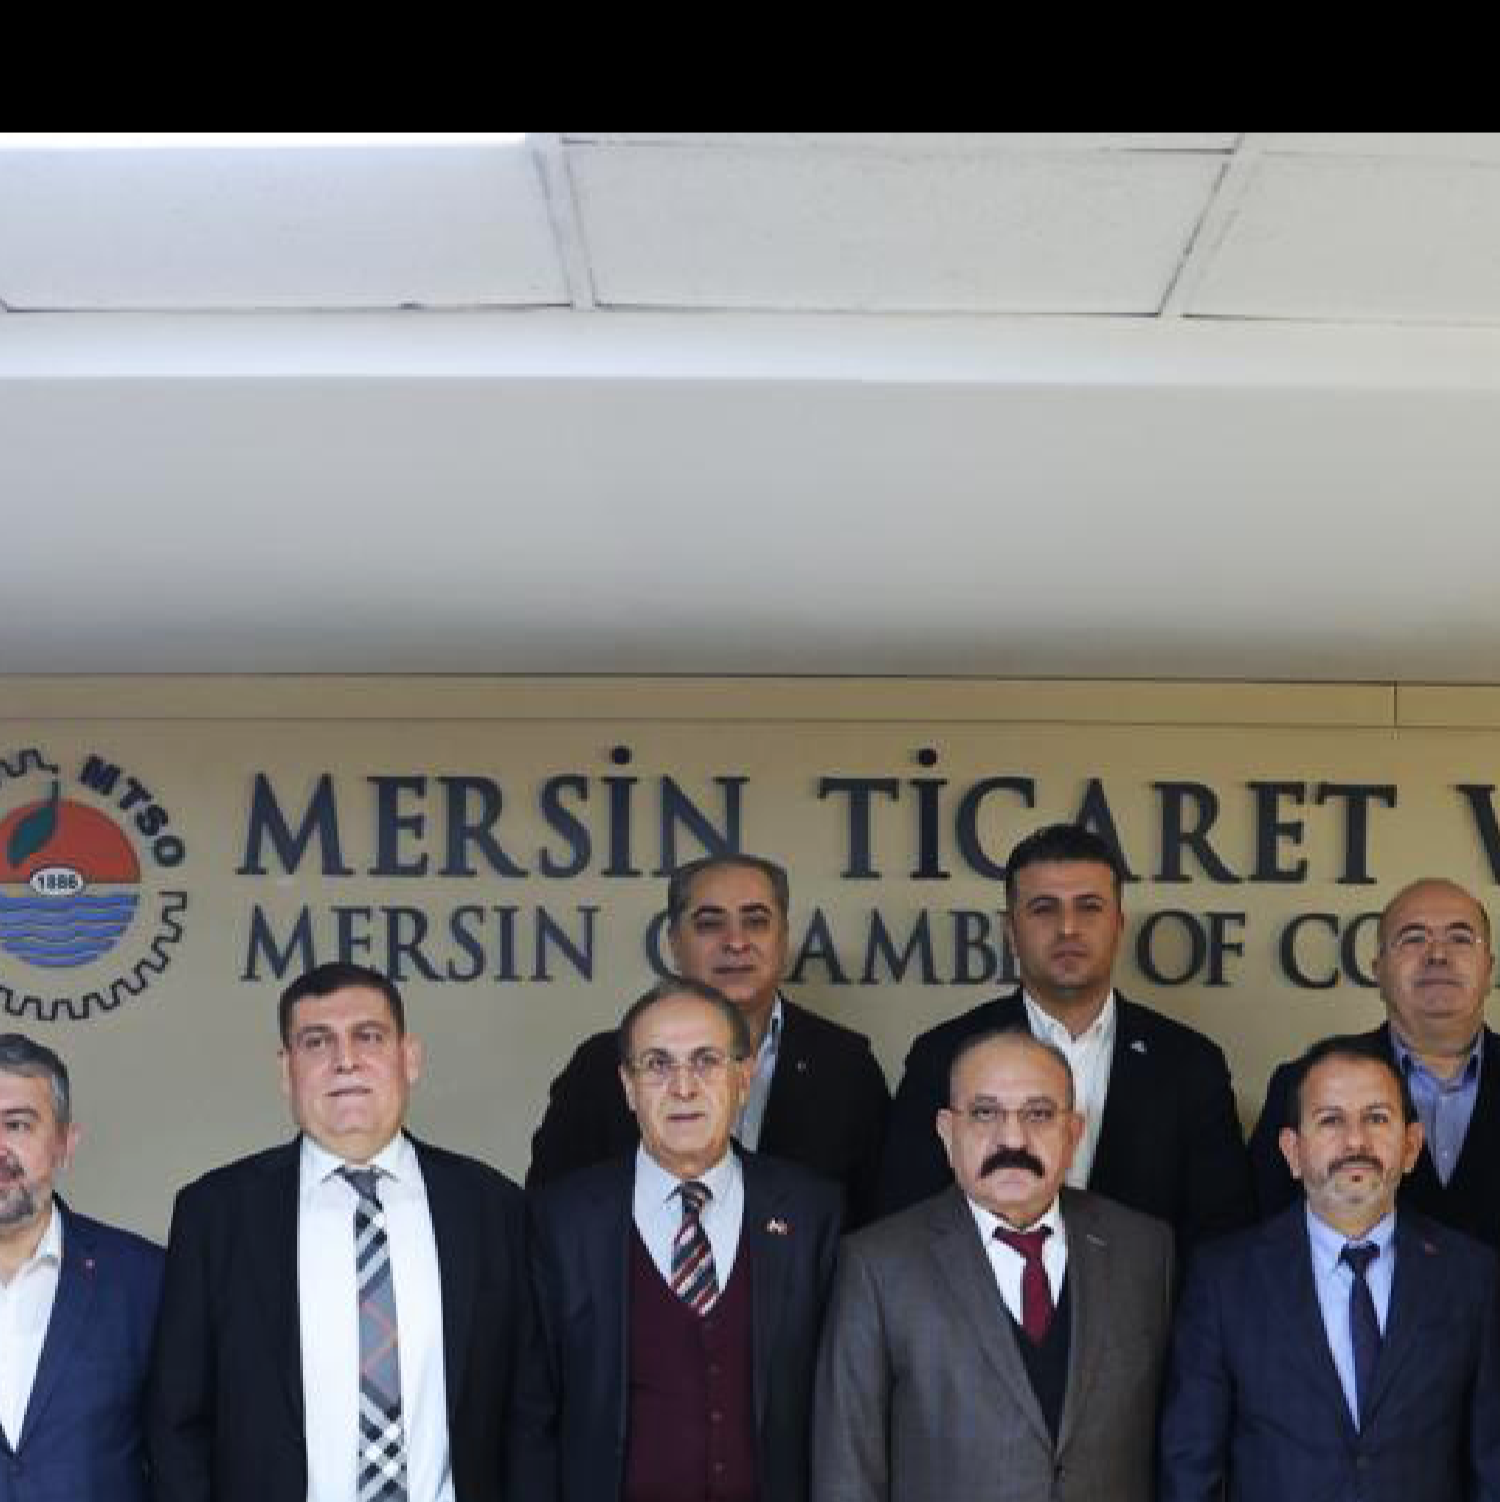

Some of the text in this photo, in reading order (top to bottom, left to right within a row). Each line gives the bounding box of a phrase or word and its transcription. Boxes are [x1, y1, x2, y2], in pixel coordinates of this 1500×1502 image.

[78, 753, 186, 868] MTSO
[235, 744, 750, 878] MERSİN
[36, 872, 77, 891] 1886
[240, 903, 600, 983] MERSIN
[644, 905, 1022, 986] CAMB
[1135, 909, 1247, 988] OF
